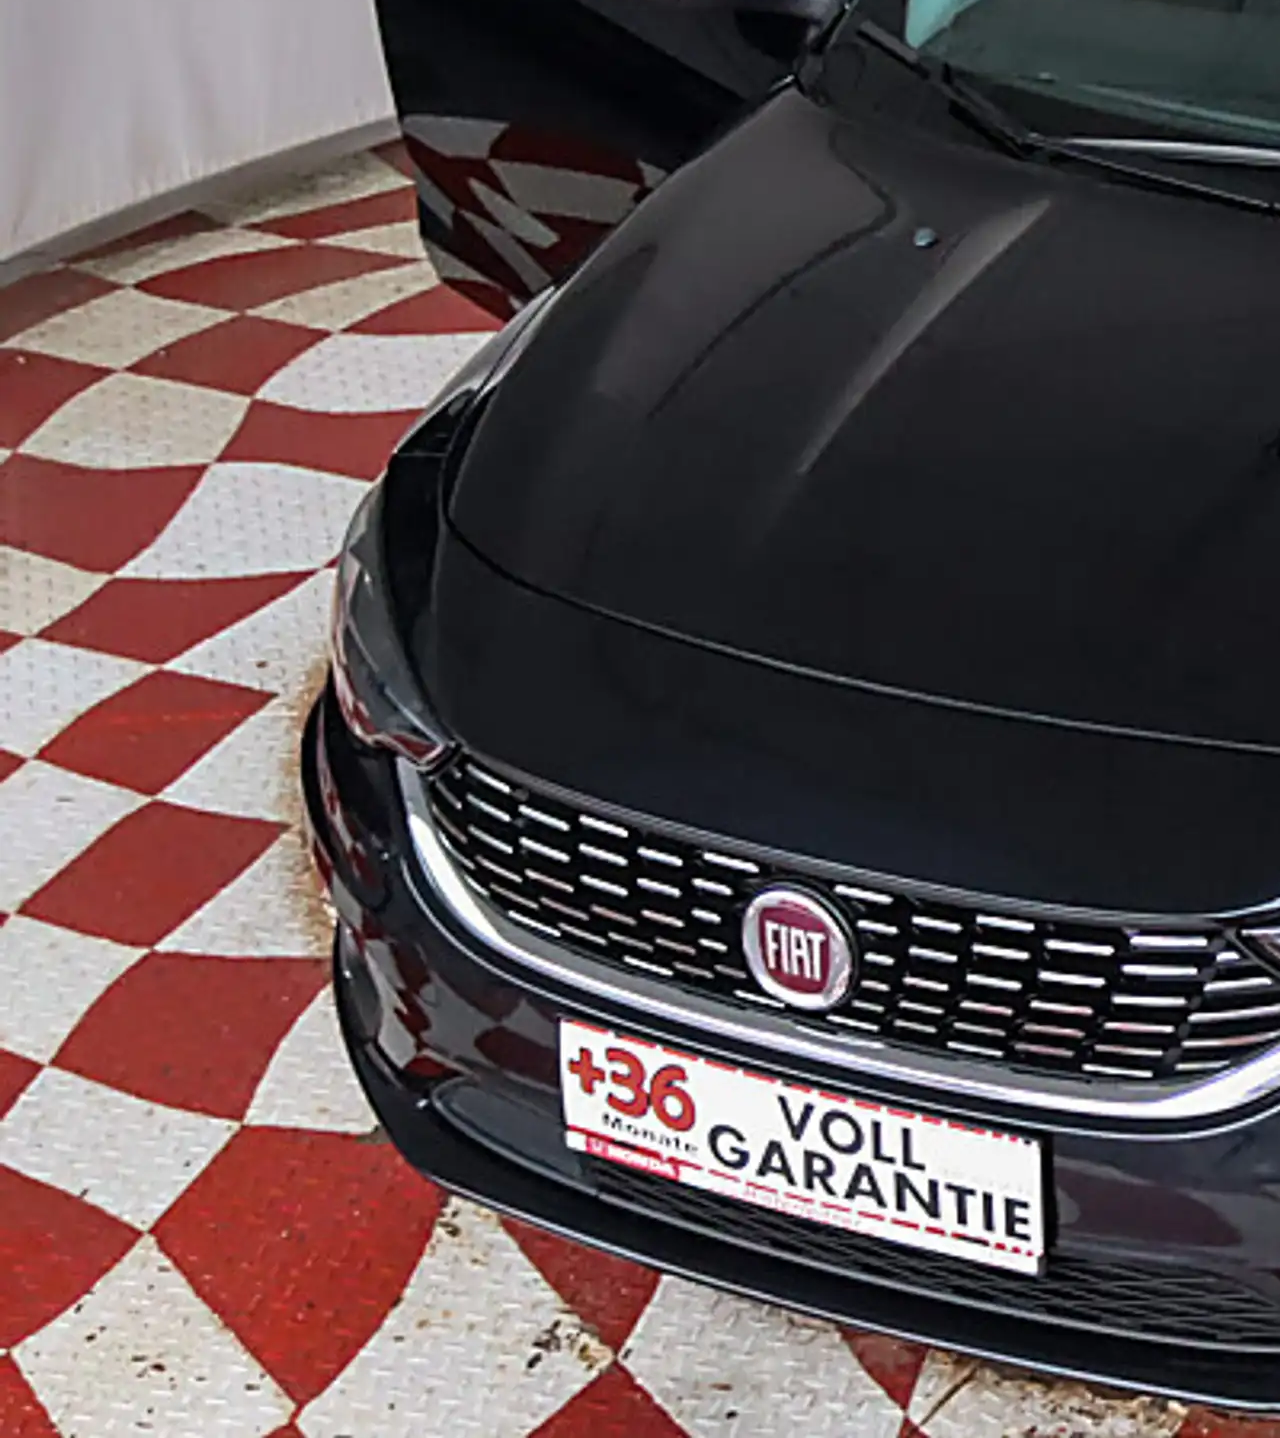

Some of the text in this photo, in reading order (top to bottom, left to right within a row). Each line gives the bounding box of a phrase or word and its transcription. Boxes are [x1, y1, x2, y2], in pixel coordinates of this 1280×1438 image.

[764, 920, 826, 982] FIAT
[568, 1047, 696, 1133] +36
[601, 1112, 699, 1156] Monate
[777, 1094, 926, 1172] VOLL
[707, 1124, 1033, 1242] GARANTIE
